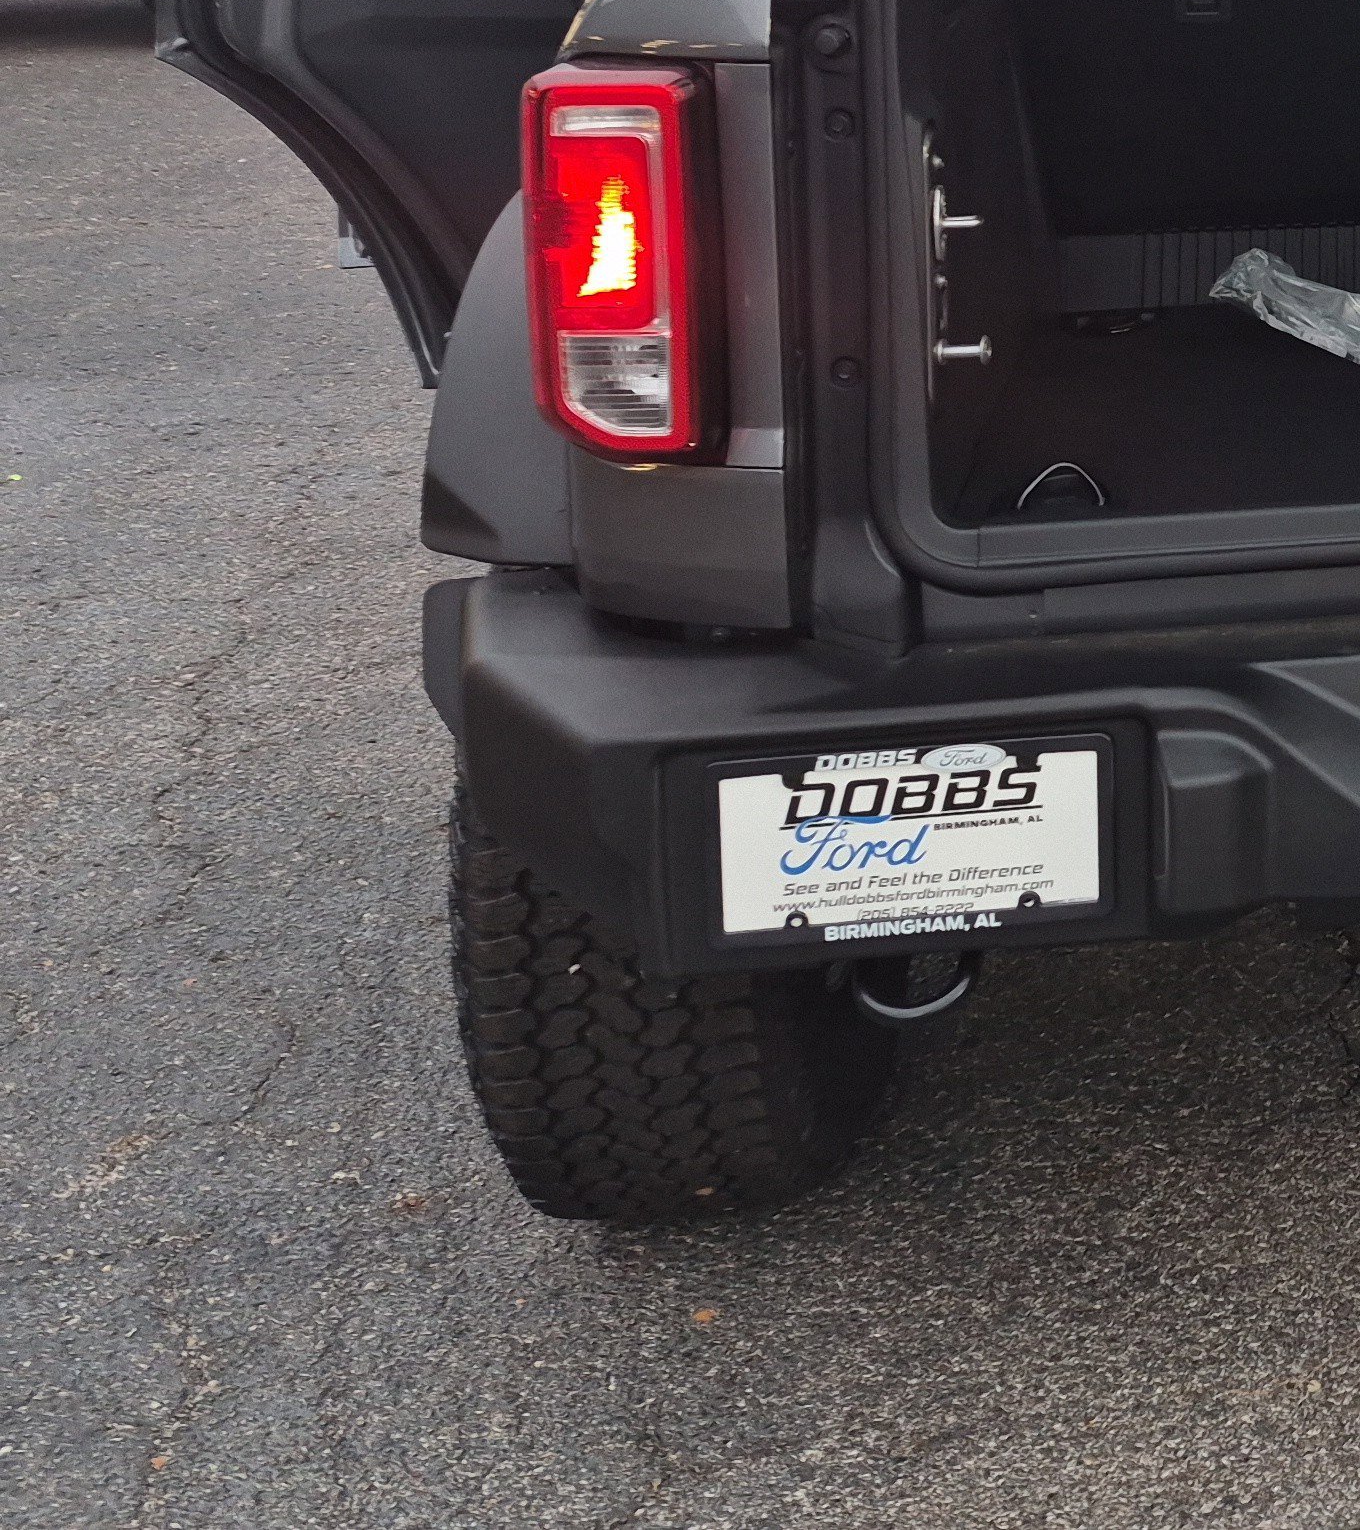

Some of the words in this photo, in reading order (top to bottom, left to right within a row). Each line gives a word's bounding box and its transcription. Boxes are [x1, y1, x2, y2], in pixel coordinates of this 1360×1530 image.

[814, 748, 918, 771] DOBBS
[940, 748, 987, 767] Ford
[785, 769, 1042, 824] DOBBS
[933, 816, 1024, 831] BIRMINGHAM,
[1027, 814, 1044, 823] AL
[780, 815, 931, 876] Ford
[773, 879, 1054, 912] www.hulldobbsfordbirmingham.com
[783, 882, 820, 897] See
[825, 876, 863, 892] and
[868, 873, 908, 888] Feel
[912, 871, 943, 885] the
[948, 864, 1044, 882] Difference
[900, 902, 975, 918] 854-2222
[824, 914, 971, 942] BIRMINGHAM,
[973, 912, 1003, 929] AL
